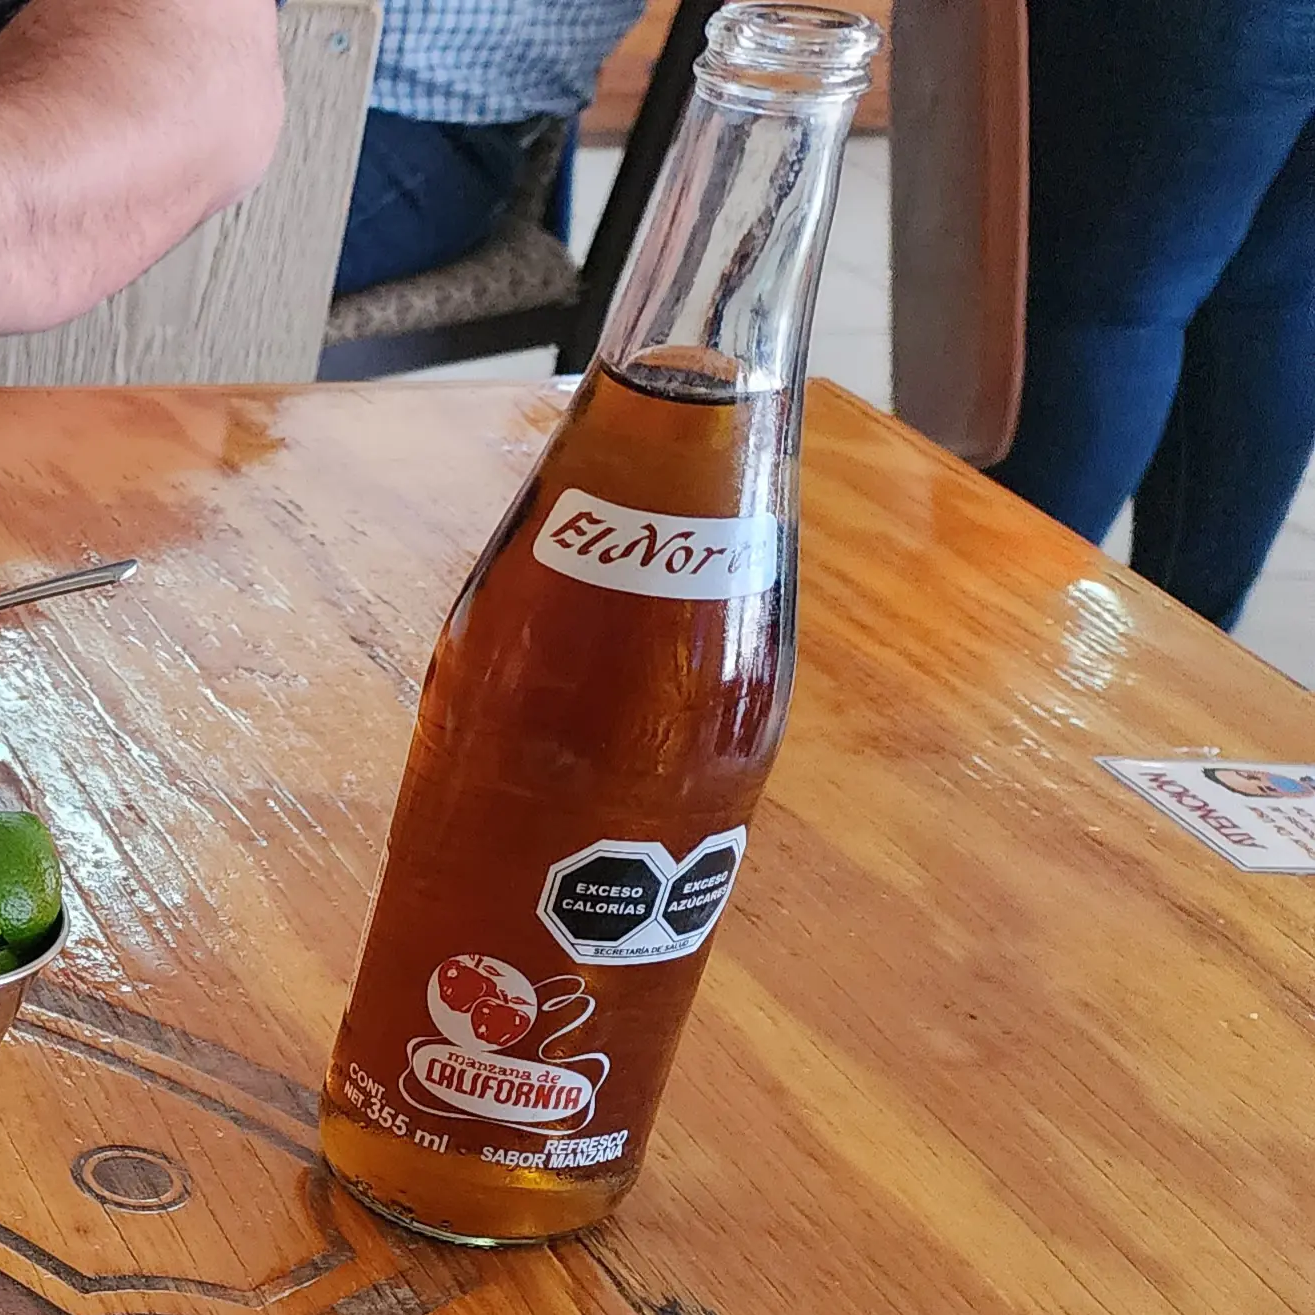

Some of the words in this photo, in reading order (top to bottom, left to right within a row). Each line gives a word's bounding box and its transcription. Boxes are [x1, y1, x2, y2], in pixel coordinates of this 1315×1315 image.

[549, 511, 617, 556] El
[575, 882, 643, 899] EXCESO
[682, 870, 729, 895] EXCESO
[562, 898, 647, 916] CALORÍAS
[667, 884, 729, 914] AZÚCARES
[593, 945, 650, 956] SECRETARÍA
[651, 945, 663, 954] DE
[664, 939, 690, 953] SALUD
[446, 1050, 532, 1081] manzana
[536, 1070, 561, 1085] de
[348, 1062, 386, 1105] CONT.
[424, 1058, 584, 1111] CALIFORNIA
[342, 1082, 366, 1113] NET.
[365, 1097, 411, 1138] 355
[414, 1127, 450, 1155] ml
[543, 1128, 630, 1155] REFRESCO
[479, 1146, 546, 1169] SABOR
[548, 1145, 623, 1170] MANZANA
